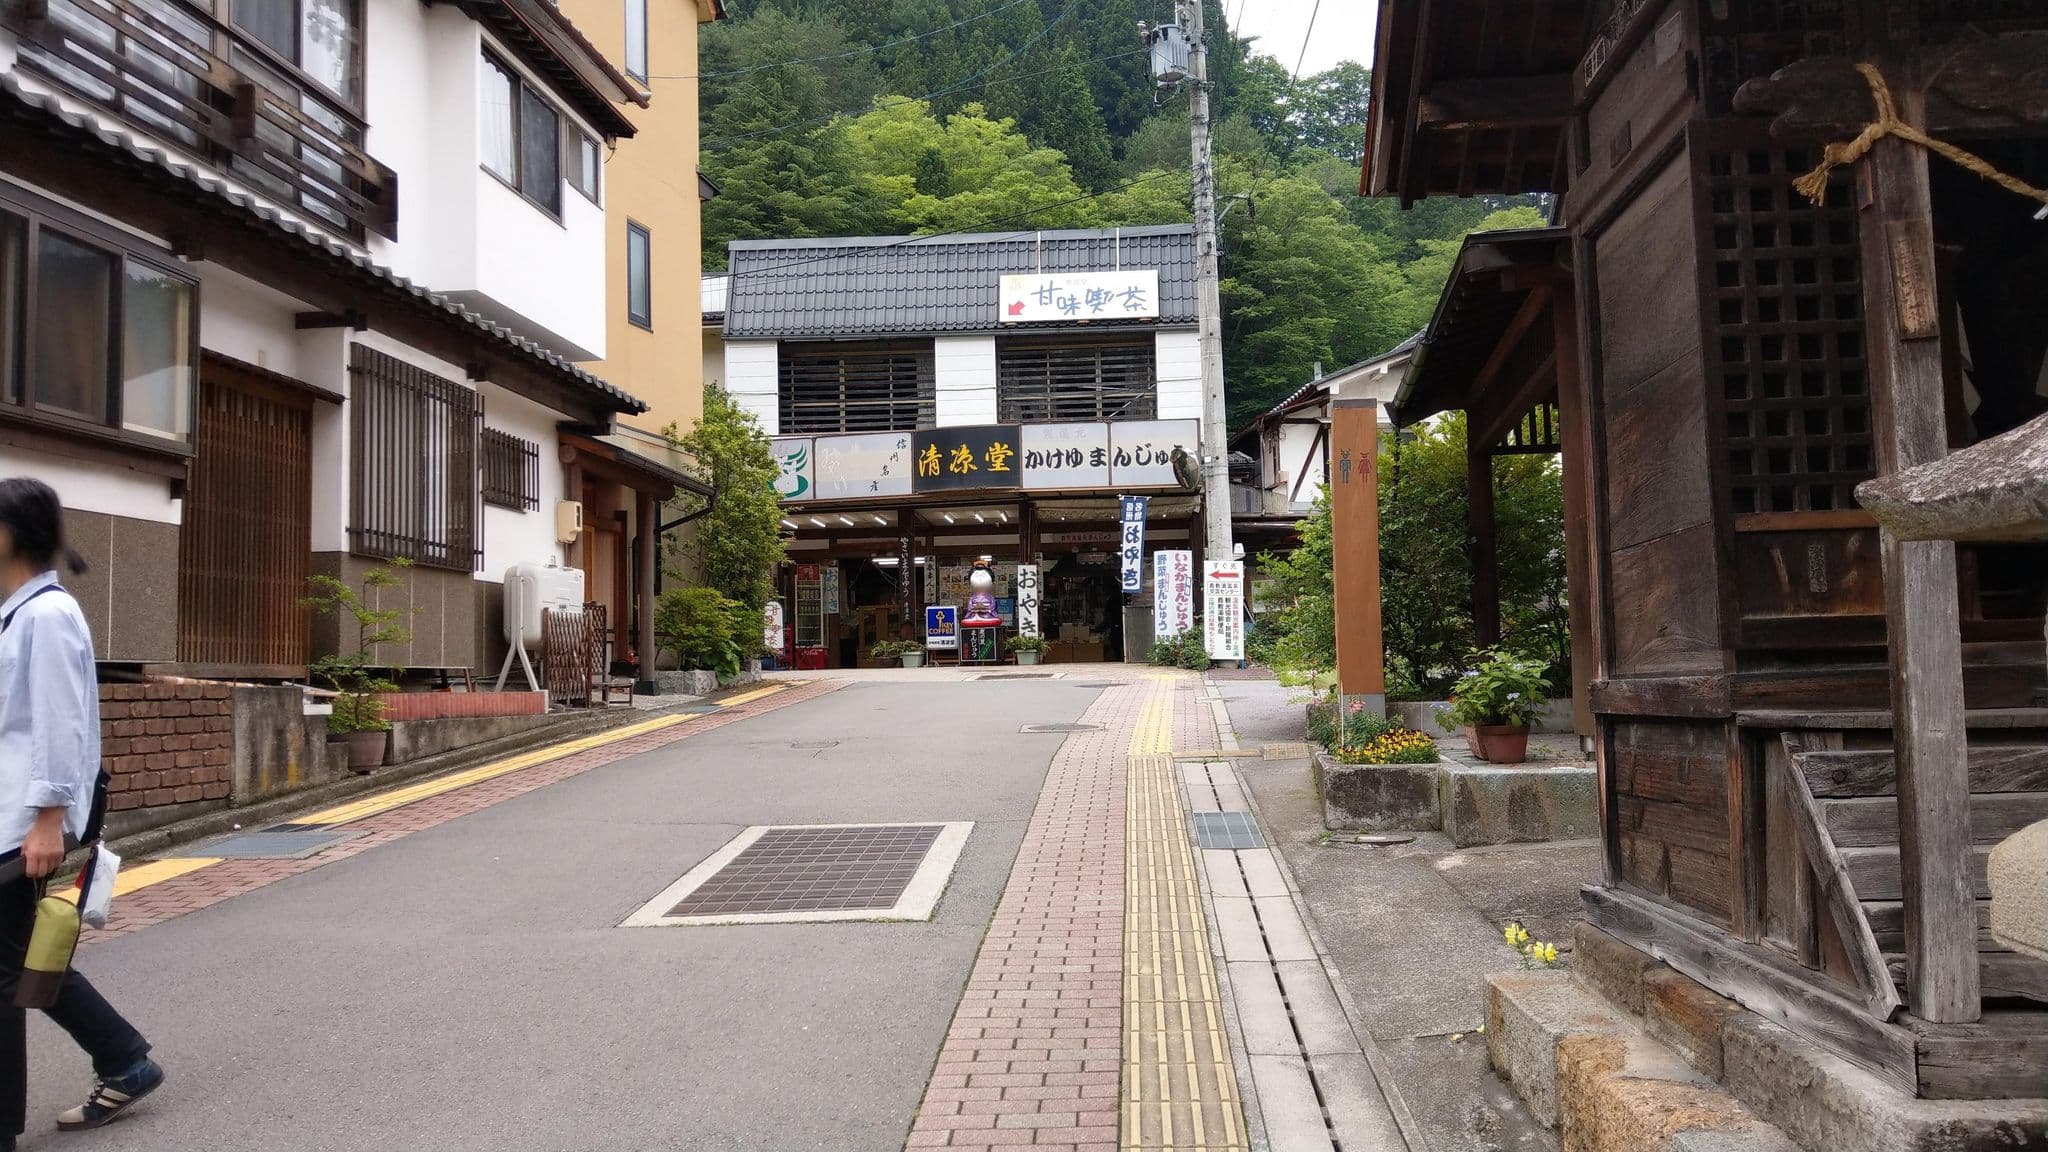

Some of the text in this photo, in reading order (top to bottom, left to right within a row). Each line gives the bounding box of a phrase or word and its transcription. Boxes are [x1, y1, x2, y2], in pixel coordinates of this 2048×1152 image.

[1030, 280, 1147, 315] 甘味喫茶
[1025, 443, 1183, 470] かけゆまんじゅ
[1018, 568, 1036, 636] おやき
[1157, 554, 1168, 631] 野菜まんじゅう
[1174, 553, 1188, 630] いなかまんじゅう
